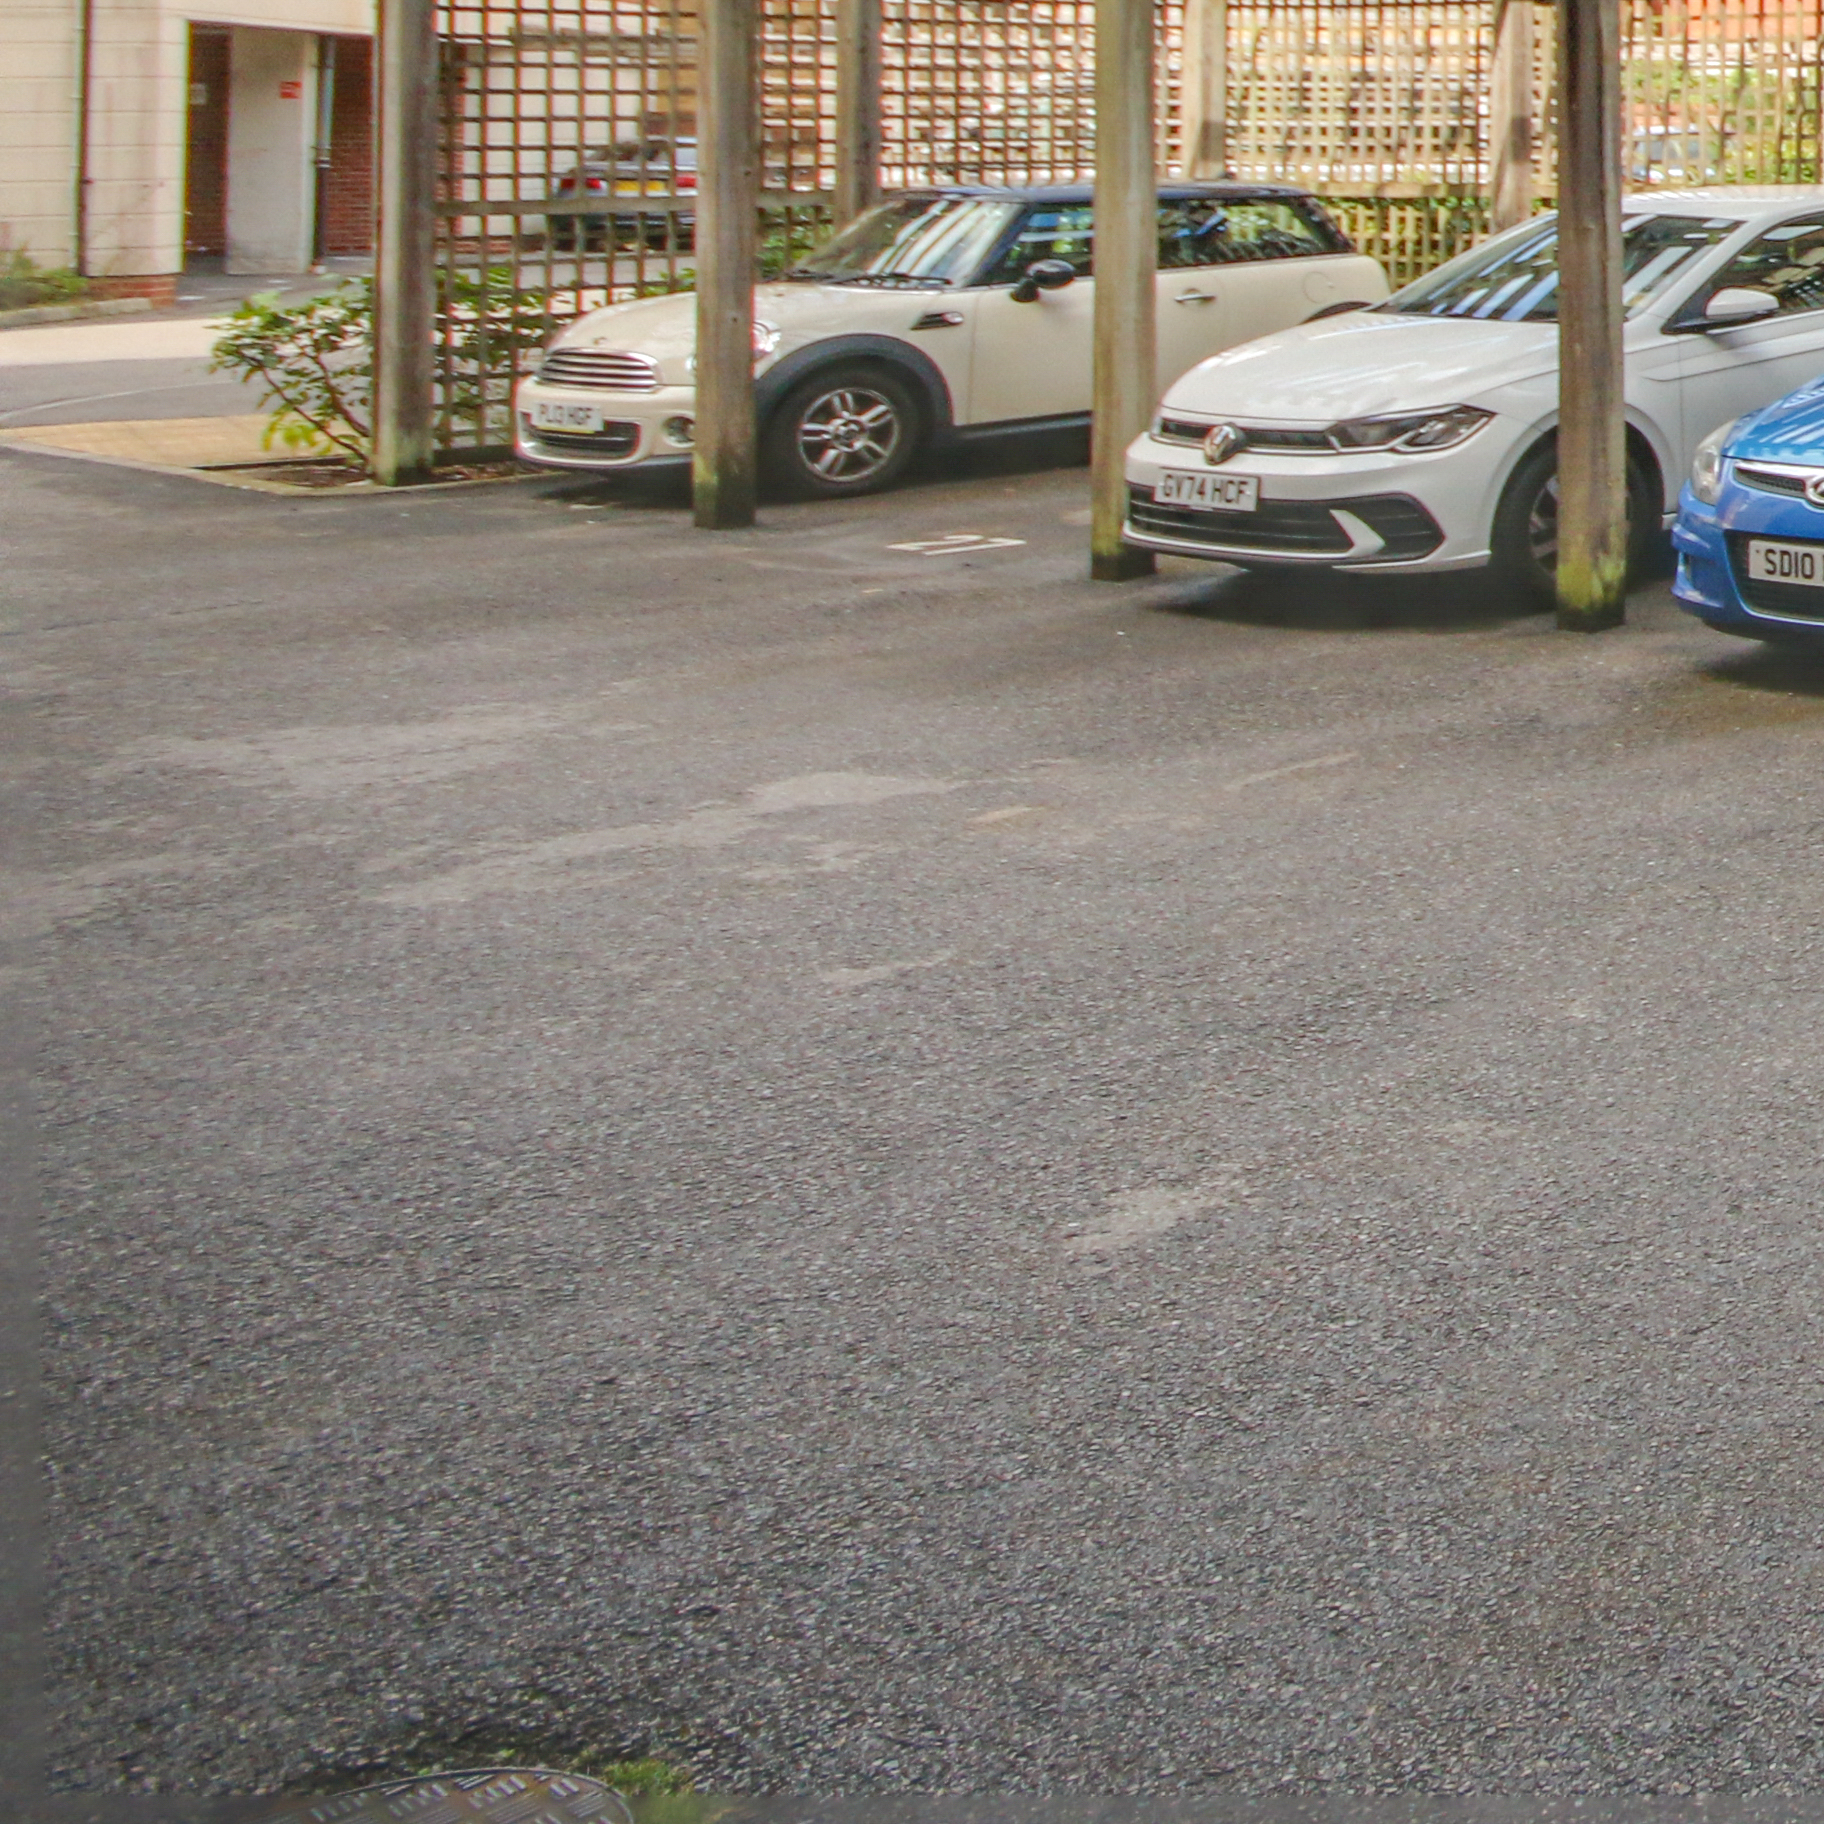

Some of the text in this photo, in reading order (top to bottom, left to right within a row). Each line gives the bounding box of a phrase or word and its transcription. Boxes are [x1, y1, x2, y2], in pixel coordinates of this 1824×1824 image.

[1163, 473, 1249, 504] GV74 HCF
[1763, 548, 1815, 579] SD10
